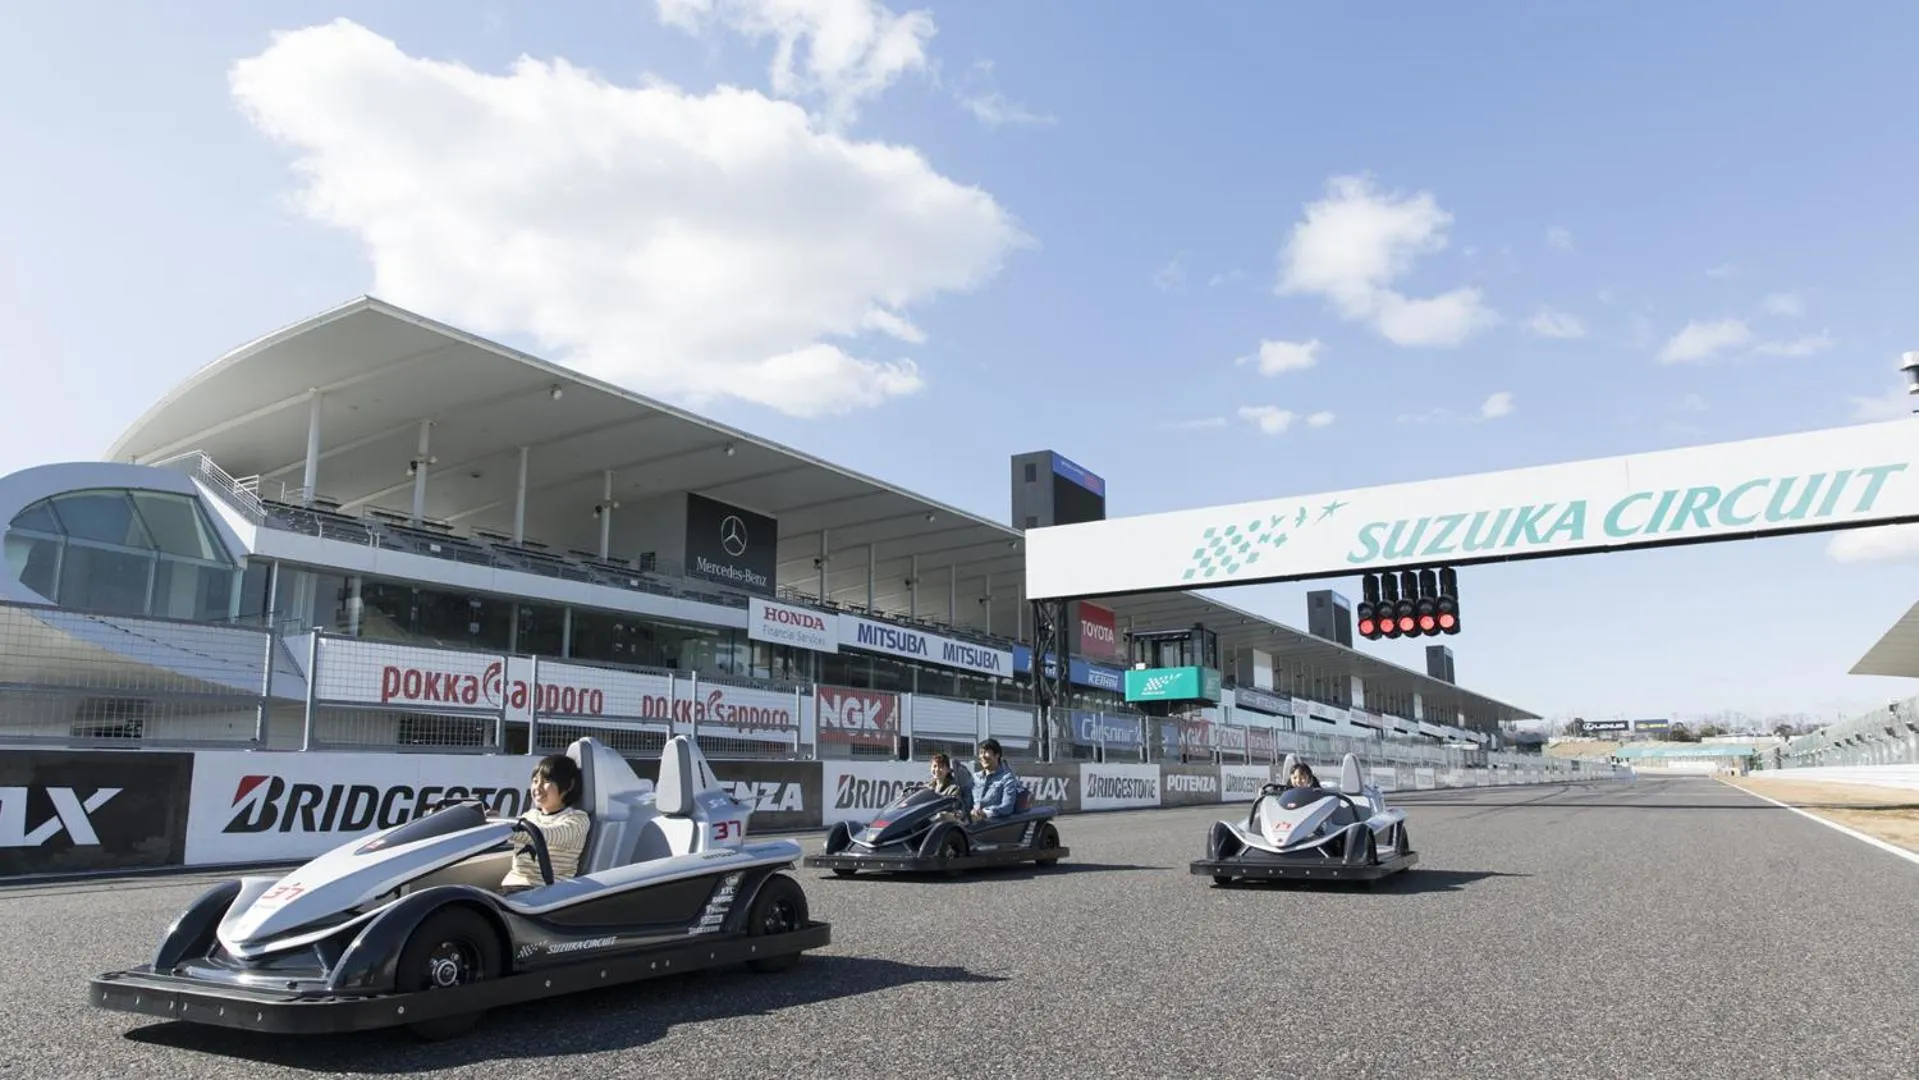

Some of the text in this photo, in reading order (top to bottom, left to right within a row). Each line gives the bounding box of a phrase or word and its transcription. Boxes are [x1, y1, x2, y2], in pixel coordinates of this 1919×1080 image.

[1347, 462, 1909, 565] SUZUKA CIRCUIT
[696, 556, 768, 587] Mercedes-Benz
[764, 606, 826, 631] HONDA
[1081, 619, 1115, 645] TOYOTA
[857, 622, 928, 656] MITSUBA
[942, 641, 1000, 671] MITSUBA
[820, 694, 883, 740] NGK
[1087, 772, 1157, 800] BRIDGESTONE
[1167, 774, 1217, 793] POTENZA
[712, 820, 742, 840] 37
